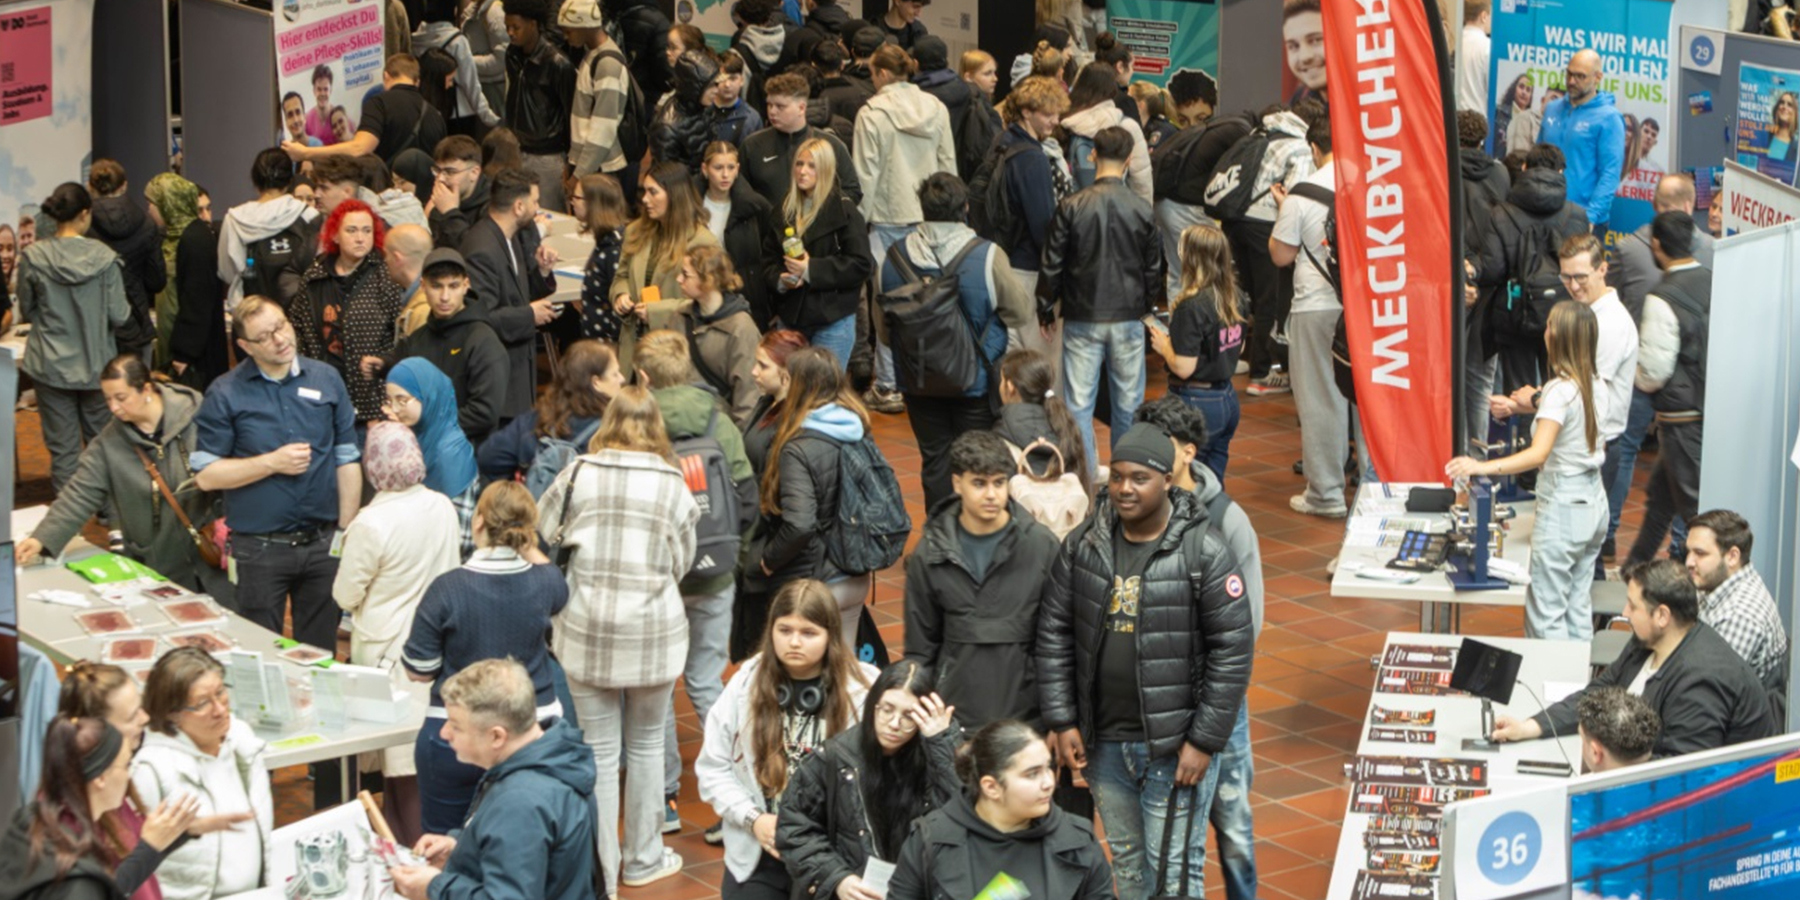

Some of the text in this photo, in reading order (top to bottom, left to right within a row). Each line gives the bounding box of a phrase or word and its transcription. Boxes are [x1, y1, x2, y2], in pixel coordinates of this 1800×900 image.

[280, 10, 376, 49] Hier entdeckst Du
[1544, 25, 1668, 59] WAS WIR MAL
[284, 29, 383, 72] deine Pflege-Skills!
[1507, 43, 1574, 67] WERDE
[1694, 45, 1710, 61] 29
[1526, 68, 1567, 92] STOL
[1624, 81, 1668, 103] UNS.
[1356, 0, 1411, 390] WECKBACHER
[1614, 185, 1655, 202] LERNE
[1730, 190, 1796, 228] WECKBA
[1491, 833, 1529, 870] 36
[1736, 853, 1763, 873] SPRING
[1763, 852, 1771, 865] IN
[1772, 847, 1791, 863] DEINE
[1780, 860, 1794, 875] FÜR
